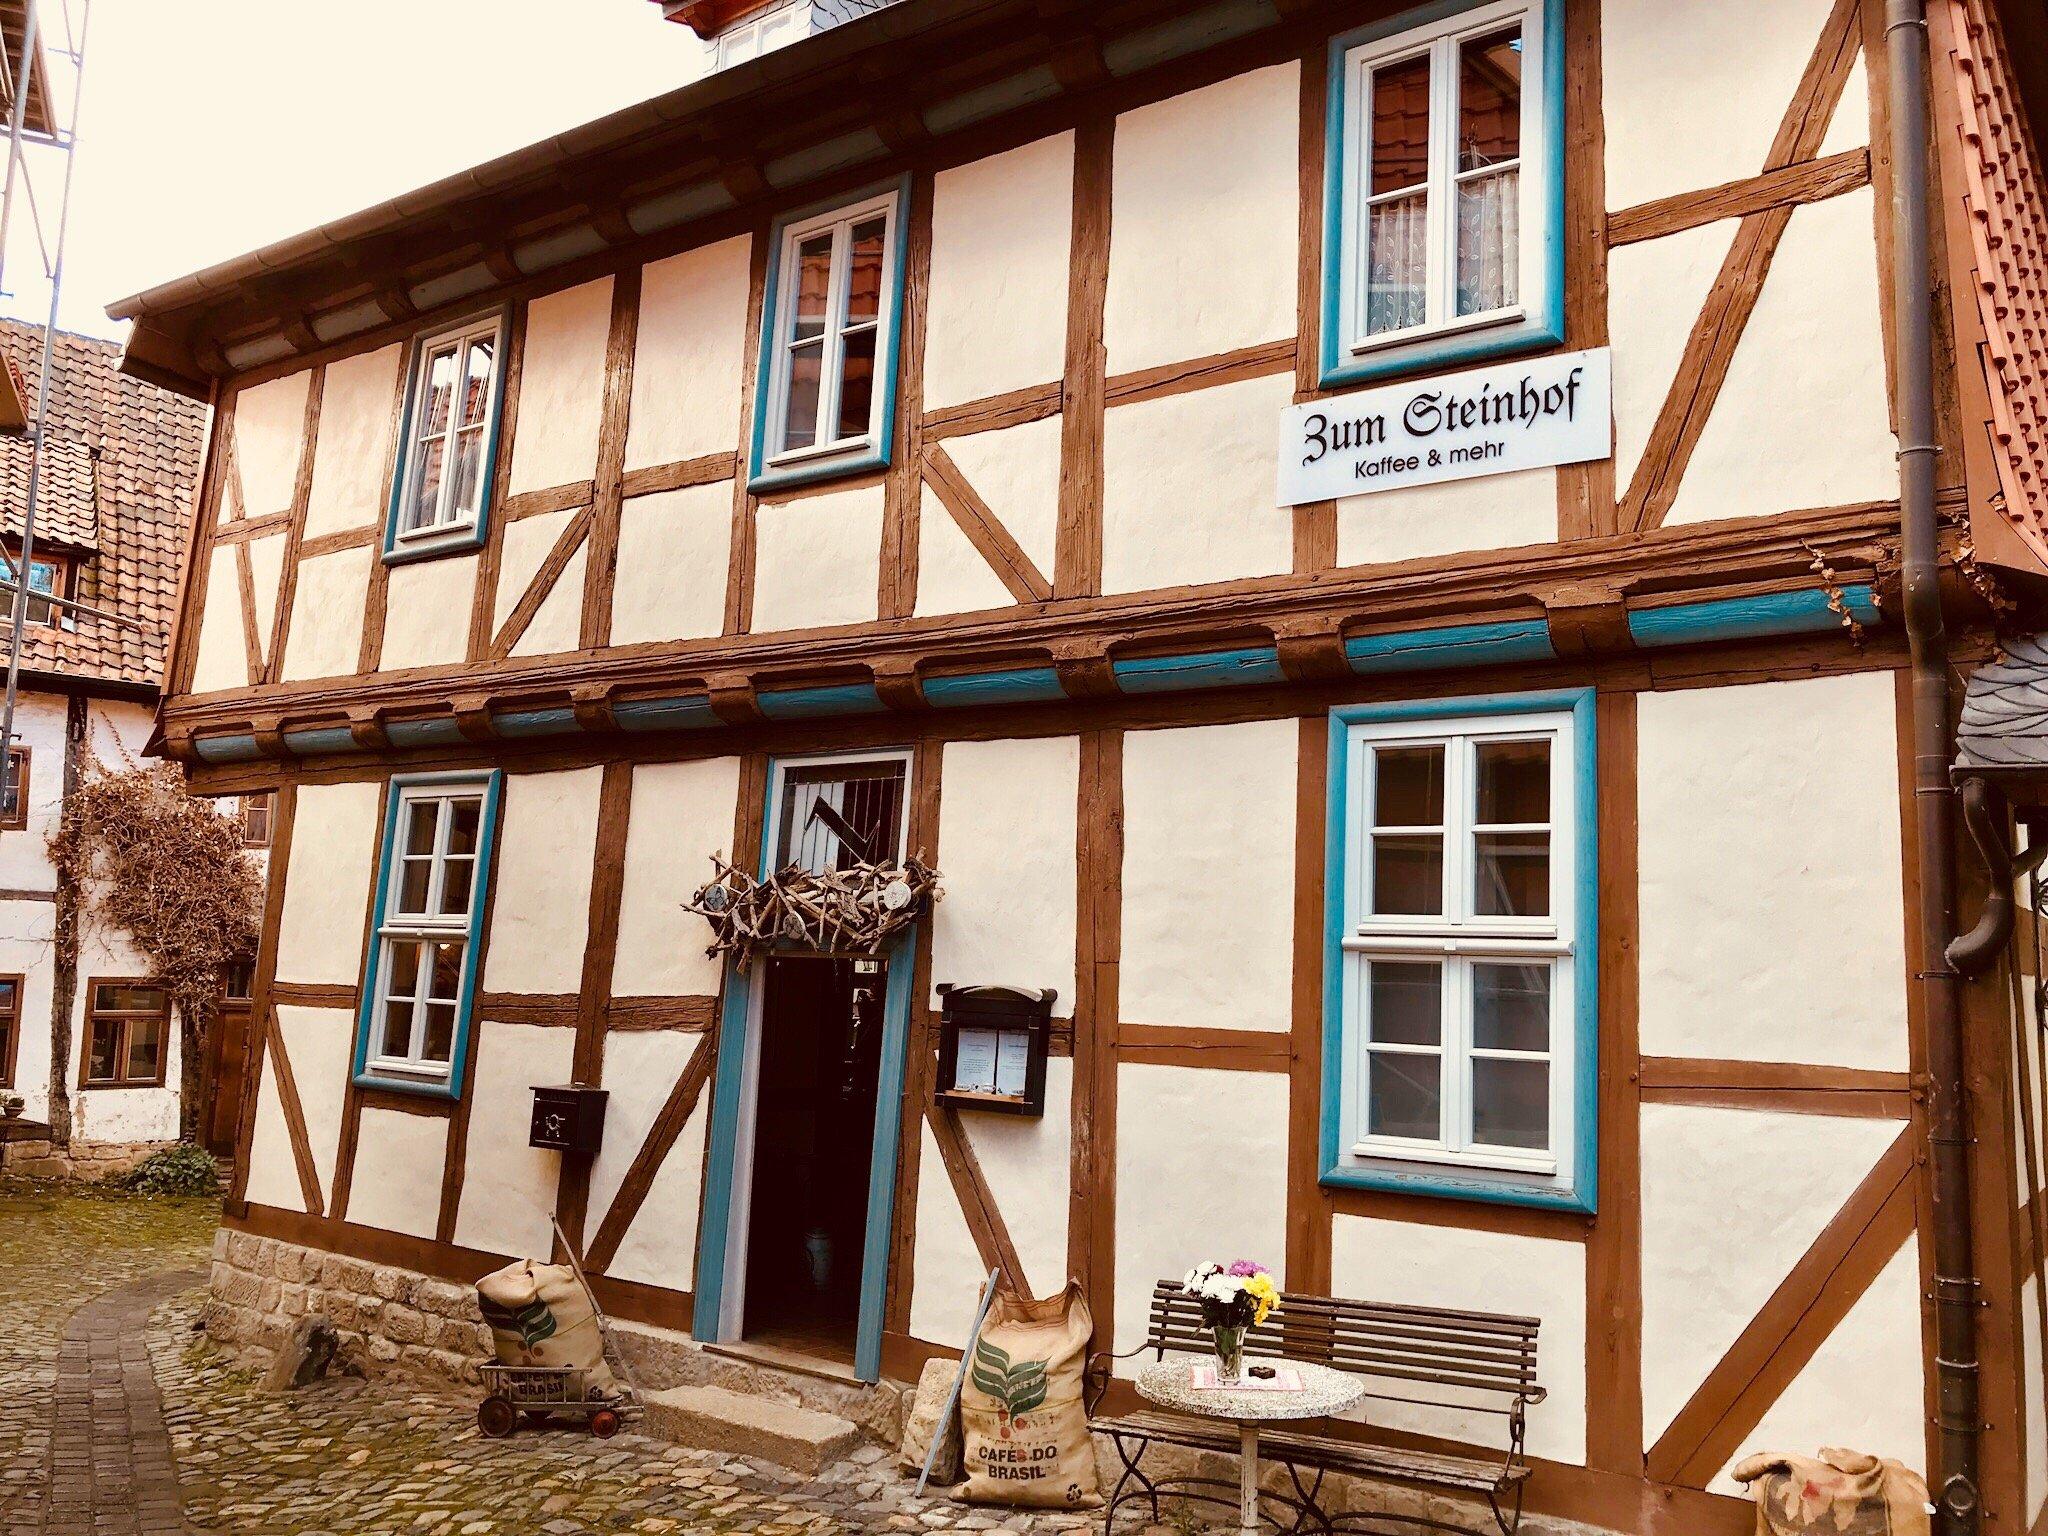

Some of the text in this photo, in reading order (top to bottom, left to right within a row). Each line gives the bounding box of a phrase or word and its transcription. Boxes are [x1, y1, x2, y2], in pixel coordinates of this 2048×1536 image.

[1302, 367, 1583, 467] Zum Steinhof
[1355, 440, 1505, 479] Kaffee & mehr
[1032, 1445, 1057, 1462] DO
[987, 1464, 1047, 1480] BRASIL
